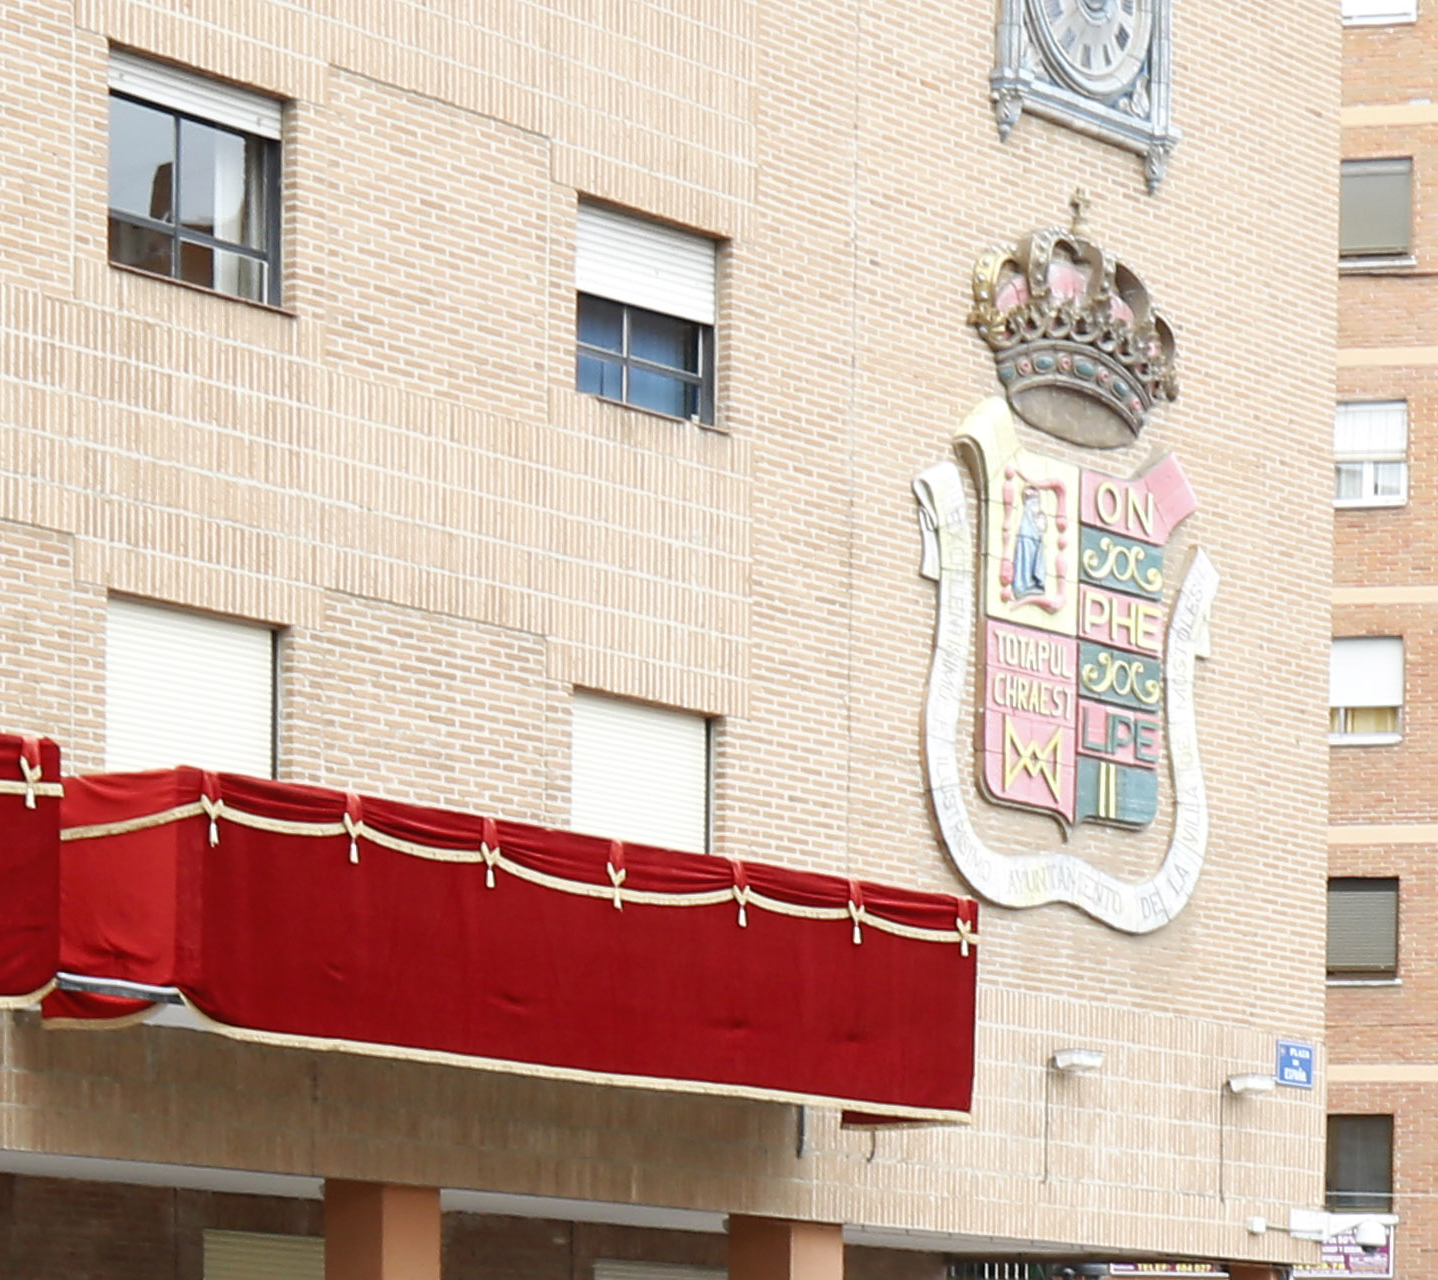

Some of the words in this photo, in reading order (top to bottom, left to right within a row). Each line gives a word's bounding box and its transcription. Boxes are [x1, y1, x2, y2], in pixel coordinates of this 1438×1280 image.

[1094, 481, 1154, 537] ON
[1083, 591, 1163, 653] PHE
[994, 630, 1073, 679] TOTAPUL
[993, 673, 1074, 721] CHRAEST
[1098, 762, 1118, 819] II
[1007, 864, 1123, 914] AYUNTAMIENTO
[1140, 891, 1164, 920] DE
[1167, 863, 1190, 896] LA
[1181, 785, 1200, 846] VILLA
